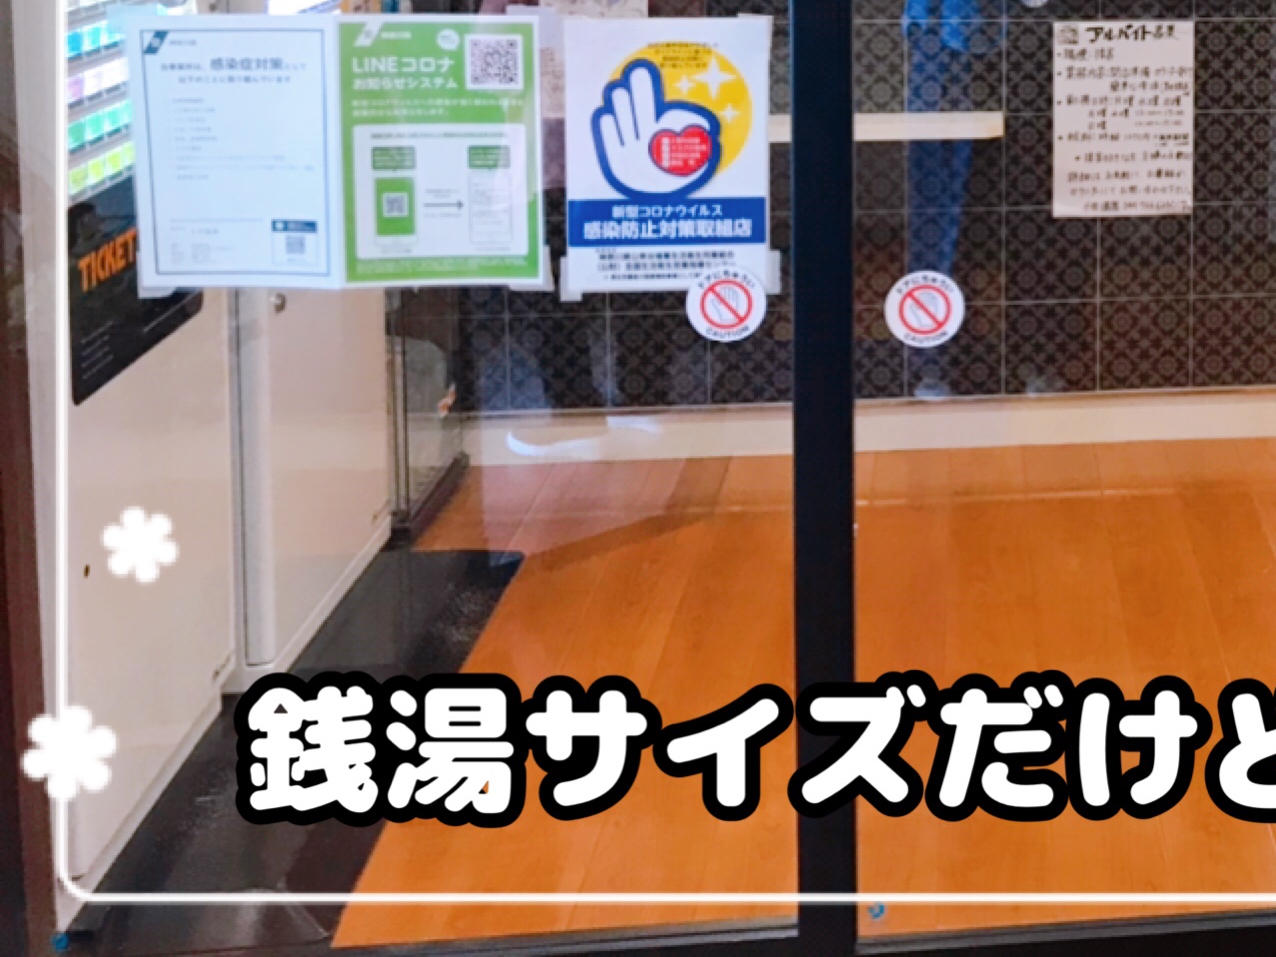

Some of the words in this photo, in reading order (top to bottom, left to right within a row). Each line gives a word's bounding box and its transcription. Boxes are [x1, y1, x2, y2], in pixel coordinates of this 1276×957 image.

[352, 56, 456, 74] LINEコロナ
[352, 76, 459, 90] お知らせシステム
[611, 204, 723, 219] 新型コロナウイルス
[583, 218, 753, 240] 感染防止対策取組店
[705, 326, 750, 340] CAUTION
